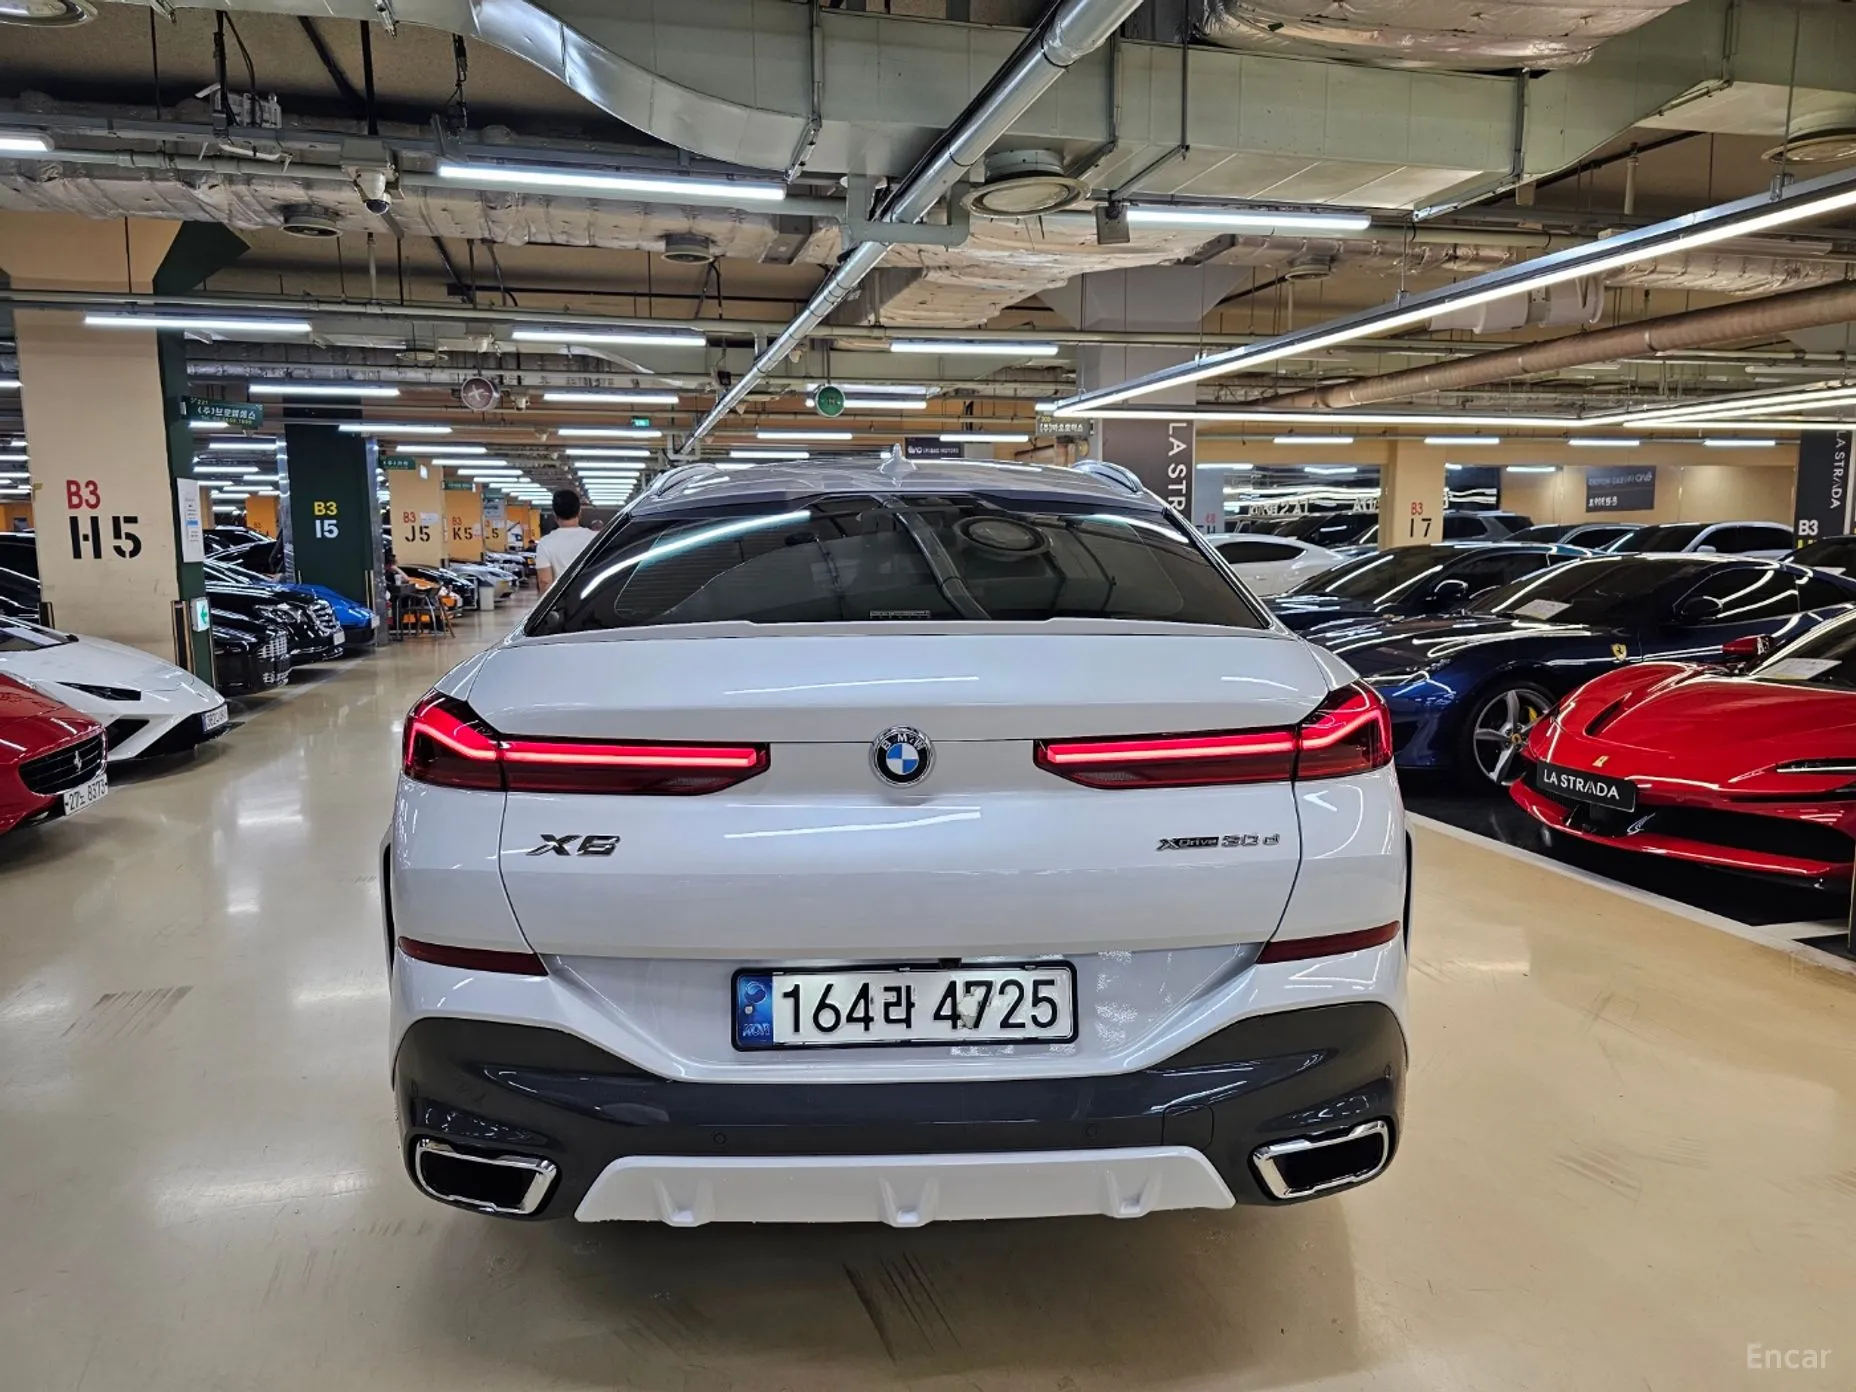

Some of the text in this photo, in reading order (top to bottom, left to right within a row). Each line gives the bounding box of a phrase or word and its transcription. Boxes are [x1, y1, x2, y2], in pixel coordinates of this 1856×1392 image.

[1168, 422, 1187, 456] LA
[1829, 451, 1846, 509] STRADA
[66, 479, 101, 509] B3
[314, 501, 338, 516] B3
[403, 511, 416, 523] B3
[1411, 502, 1424, 515] B3
[405, 525, 430, 542] J5
[453, 527, 473, 540] K5
[1798, 519, 1819, 536] B3
[881, 733, 925, 751] BMW
[1544, 769, 1620, 800] LA STRADA
[526, 834, 621, 856] X6
[782, 978, 1059, 1034] 164라 4725
